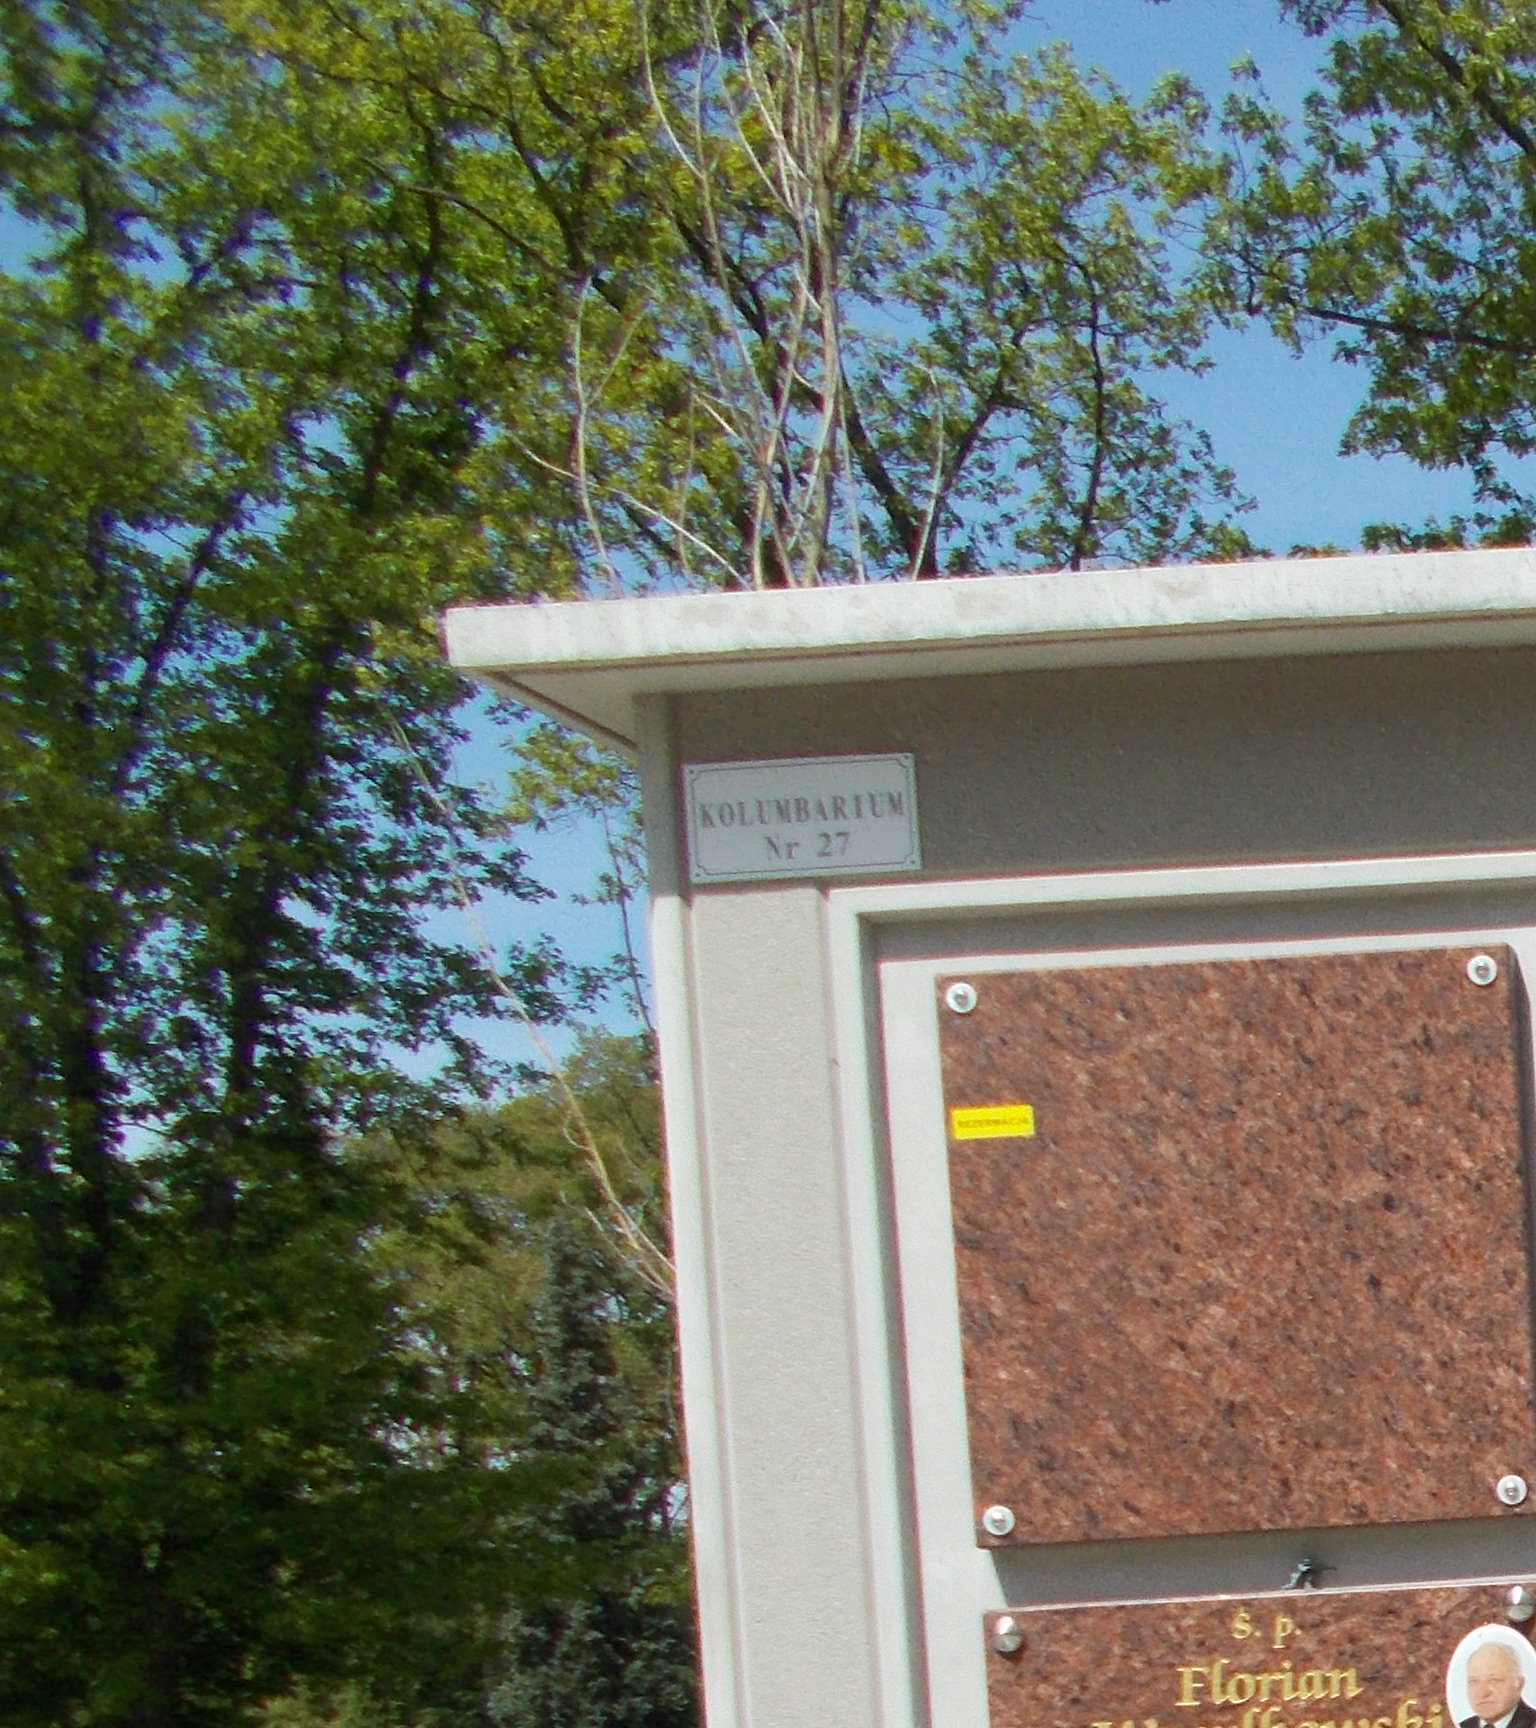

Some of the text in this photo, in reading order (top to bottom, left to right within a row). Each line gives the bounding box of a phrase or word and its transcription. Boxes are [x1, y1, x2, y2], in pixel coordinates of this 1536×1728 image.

[701, 790, 905, 828] KOLUMBARIUM
[764, 831, 851, 860] Nr 27
[1175, 1659, 1363, 1707] Florian
